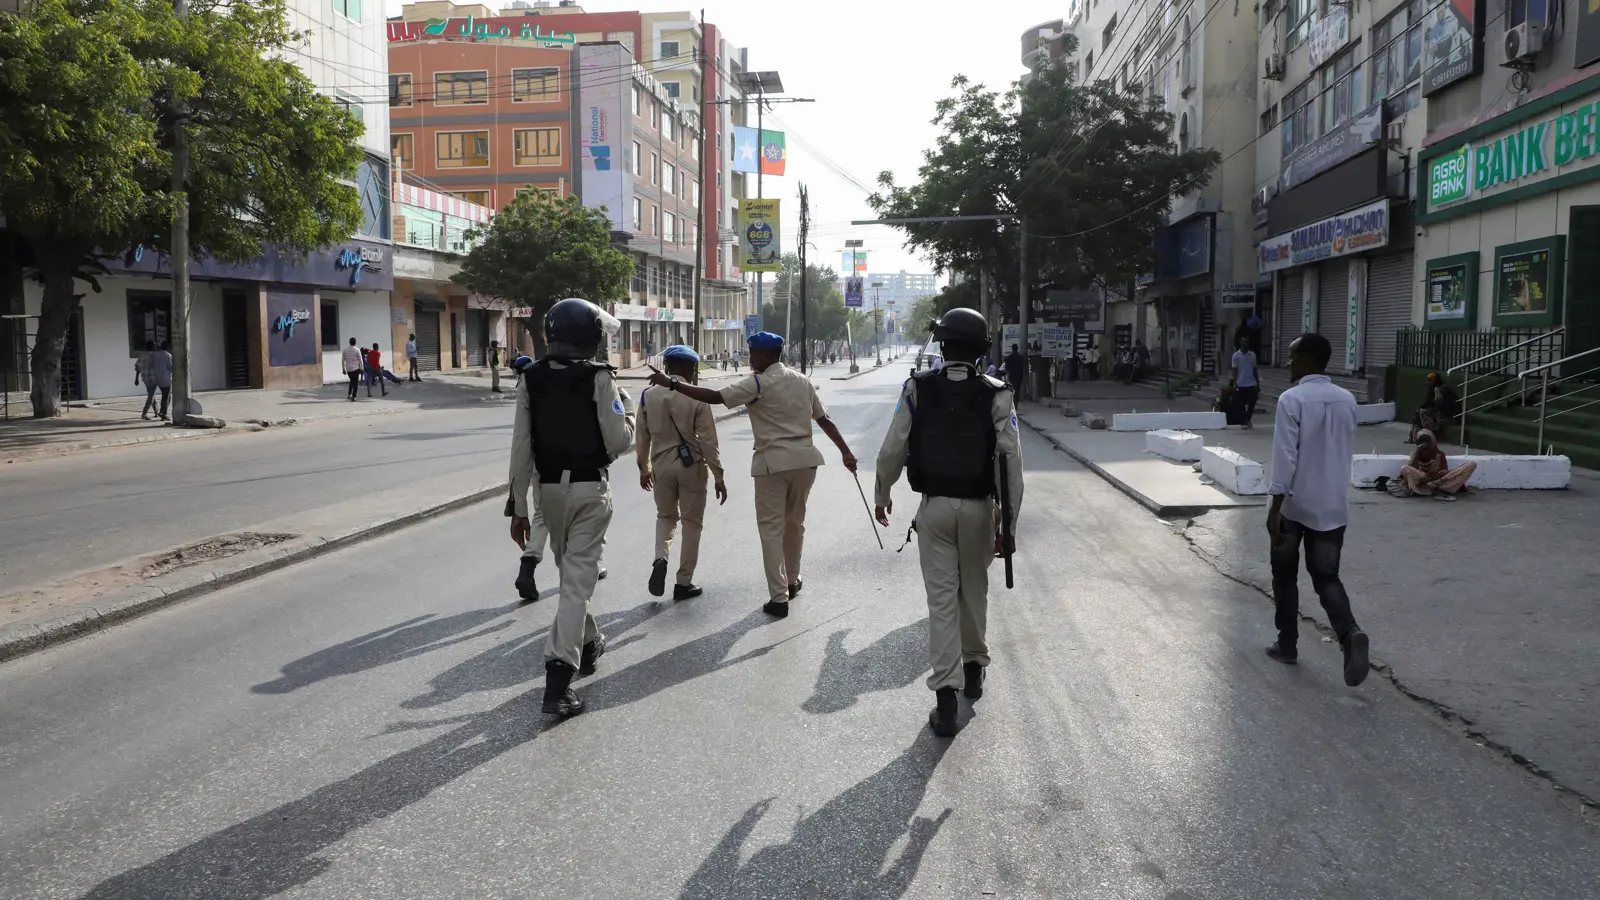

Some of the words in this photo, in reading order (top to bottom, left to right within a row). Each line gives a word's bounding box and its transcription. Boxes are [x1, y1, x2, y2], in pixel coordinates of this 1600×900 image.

[459, 15, 511, 41] مول
[520, 23, 576, 48] حياة
[590, 106, 599, 144] National
[1475, 120, 1546, 190] BANK
[1555, 101, 1600, 166] BE
[1433, 154, 1465, 181] AGRO
[1432, 175, 1464, 199] BANK
[750, 230, 770, 239] 6GB
